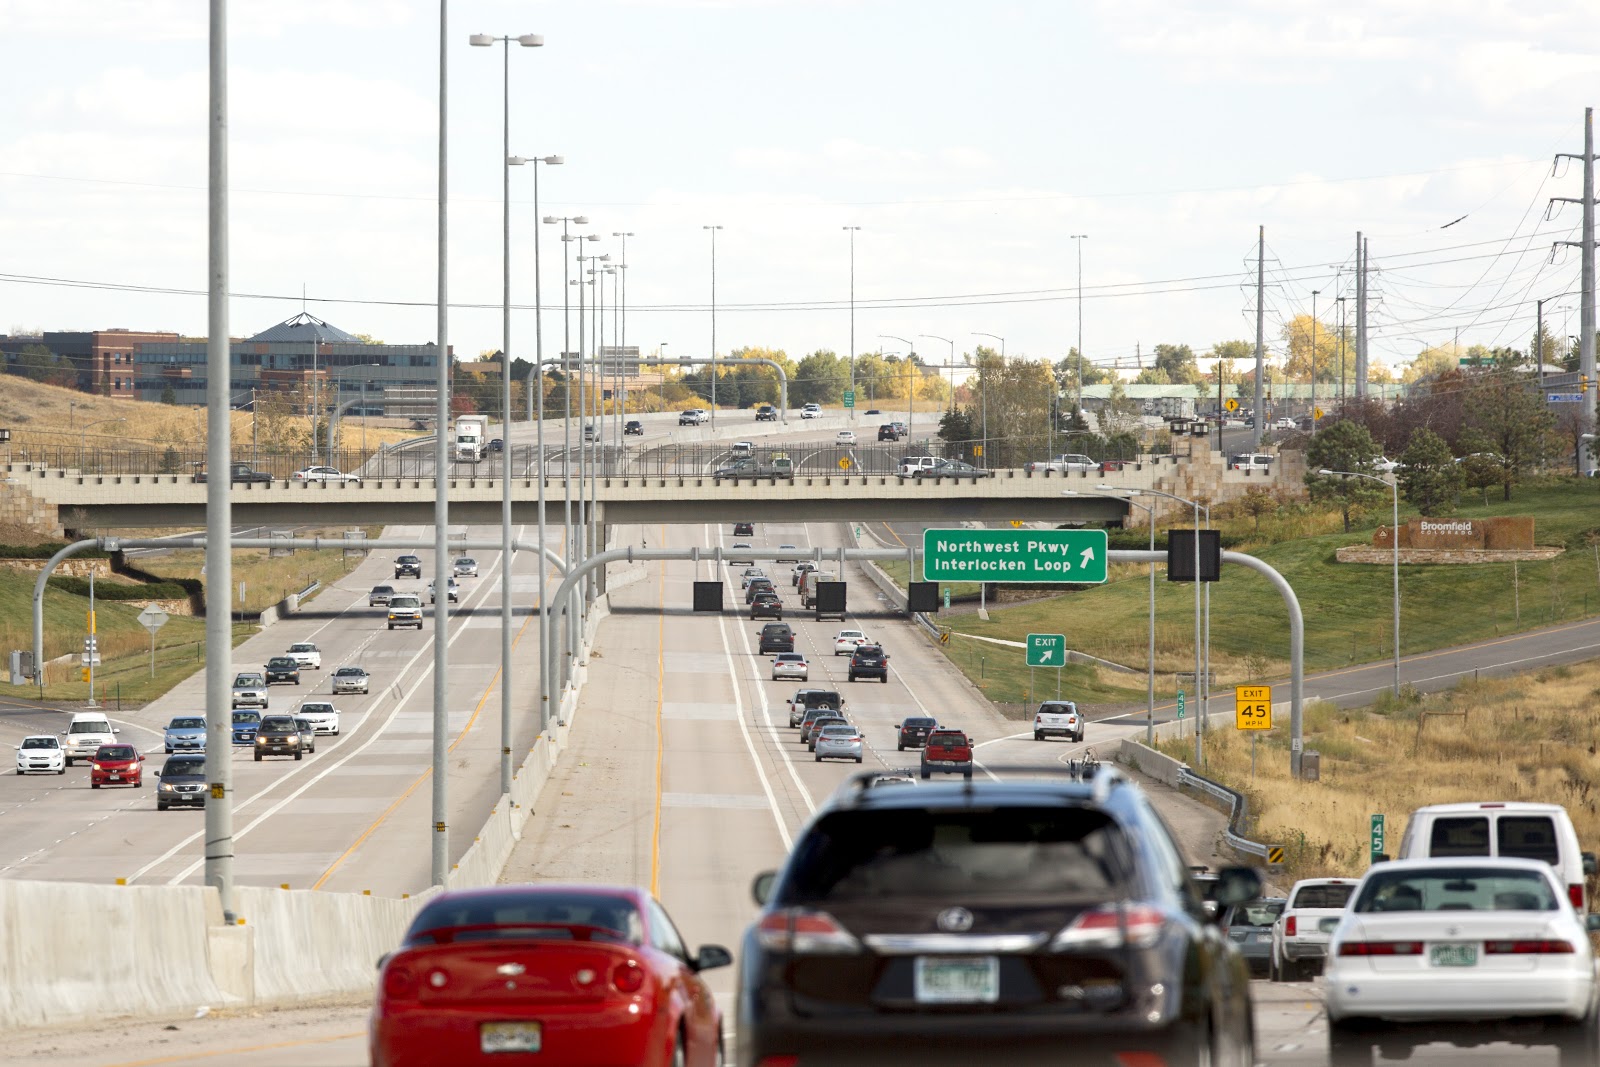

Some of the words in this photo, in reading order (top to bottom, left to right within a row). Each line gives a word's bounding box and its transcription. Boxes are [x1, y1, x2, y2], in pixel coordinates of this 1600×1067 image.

[1421, 521, 1472, 530] Broomfield
[937, 540, 1019, 553] Northwest
[1027, 541, 1069, 555] Pkwy
[935, 558, 1026, 571] Interlocken
[1034, 559, 1071, 572] Loop
[1035, 638, 1057, 646] EXIT
[1241, 704, 1266, 718] 45
